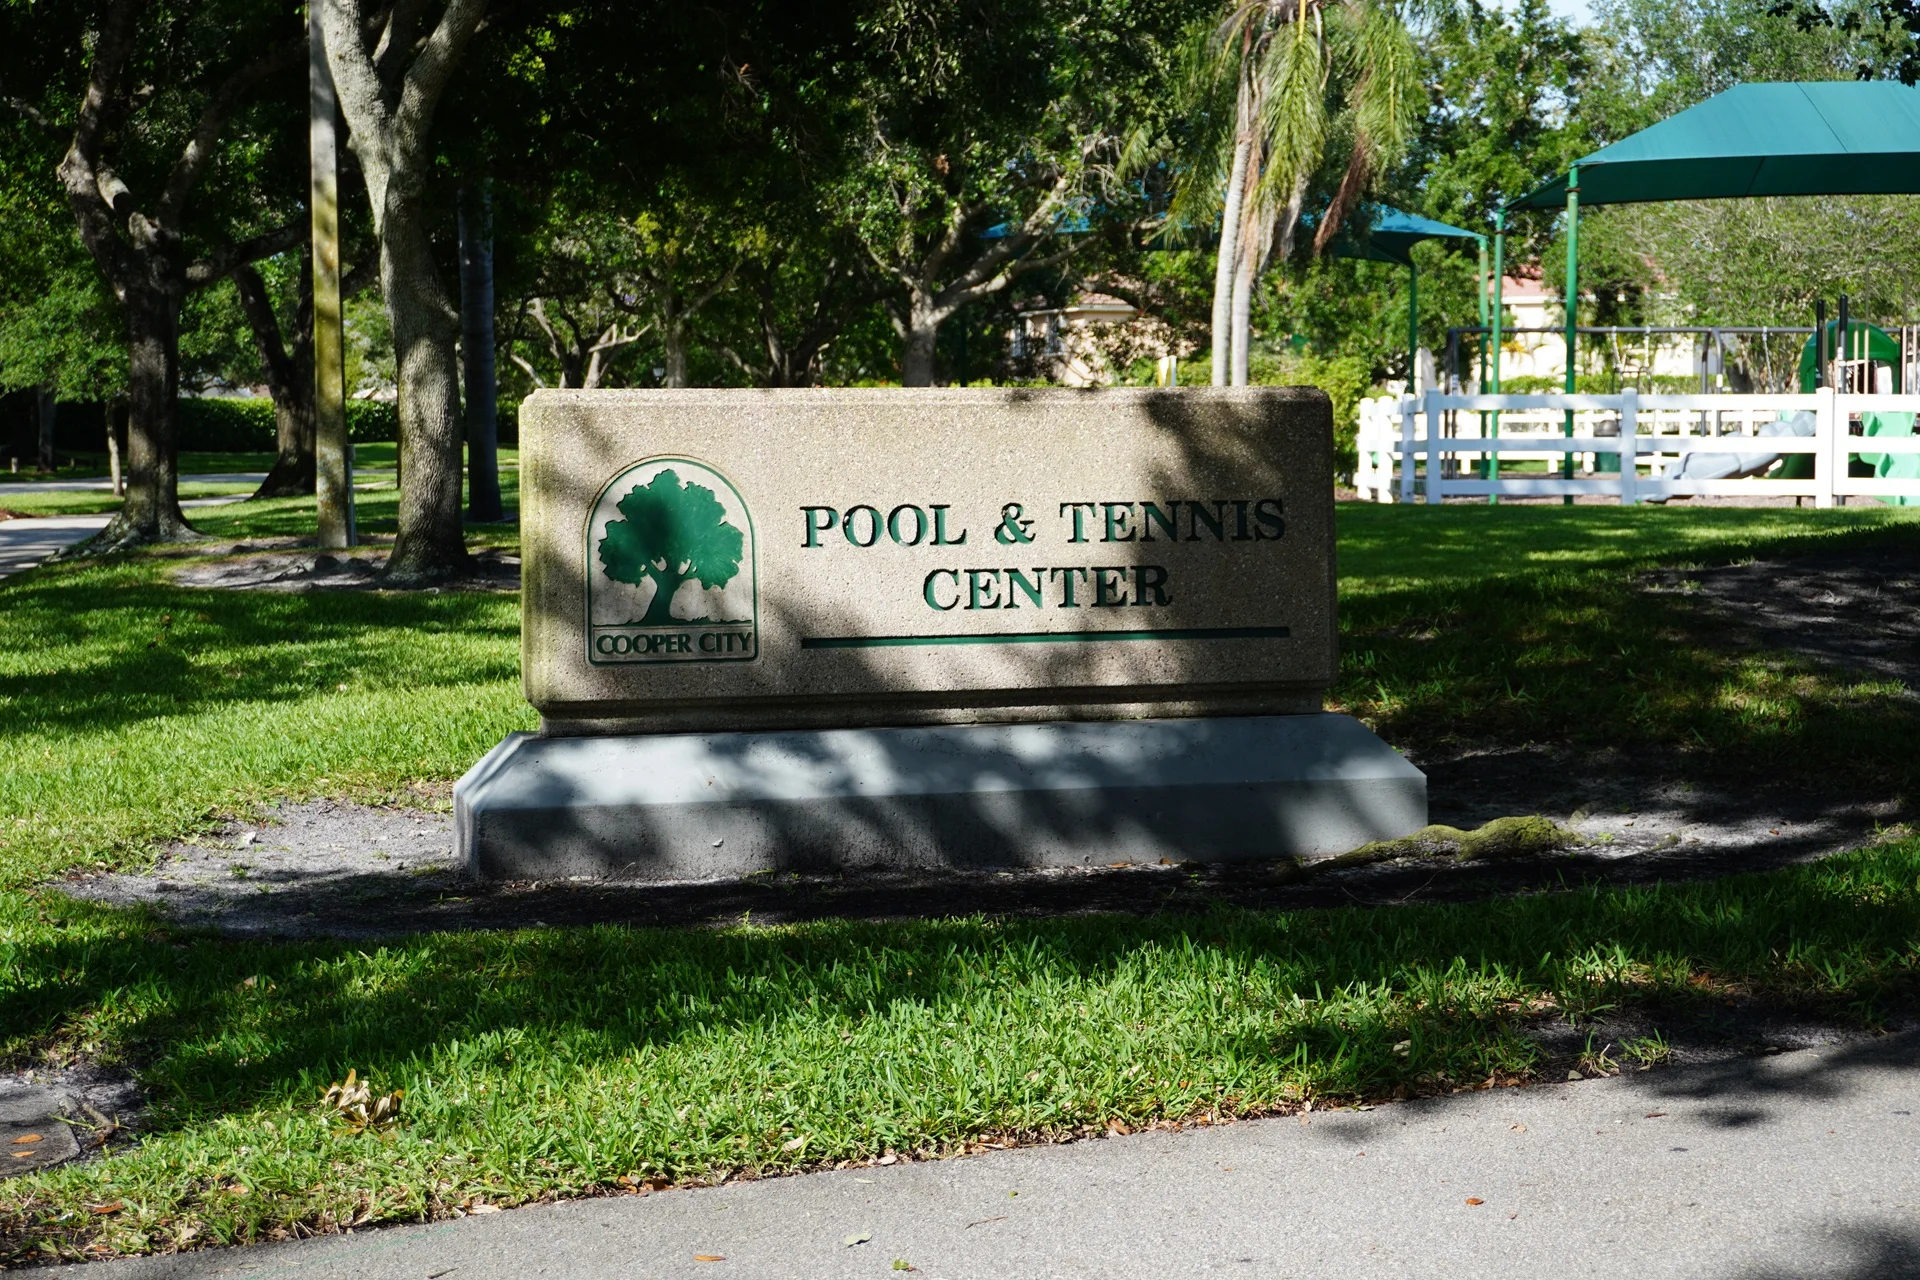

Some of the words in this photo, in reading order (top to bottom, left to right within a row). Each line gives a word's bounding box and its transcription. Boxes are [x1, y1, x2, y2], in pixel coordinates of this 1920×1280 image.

[800, 503, 967, 549] POOL
[994, 501, 1036, 547] &
[1060, 498, 1285, 544] TENNIS
[923, 564, 1173, 611] CENTER
[596, 633, 694, 655] COOPER
[698, 632, 753, 653] CITY
